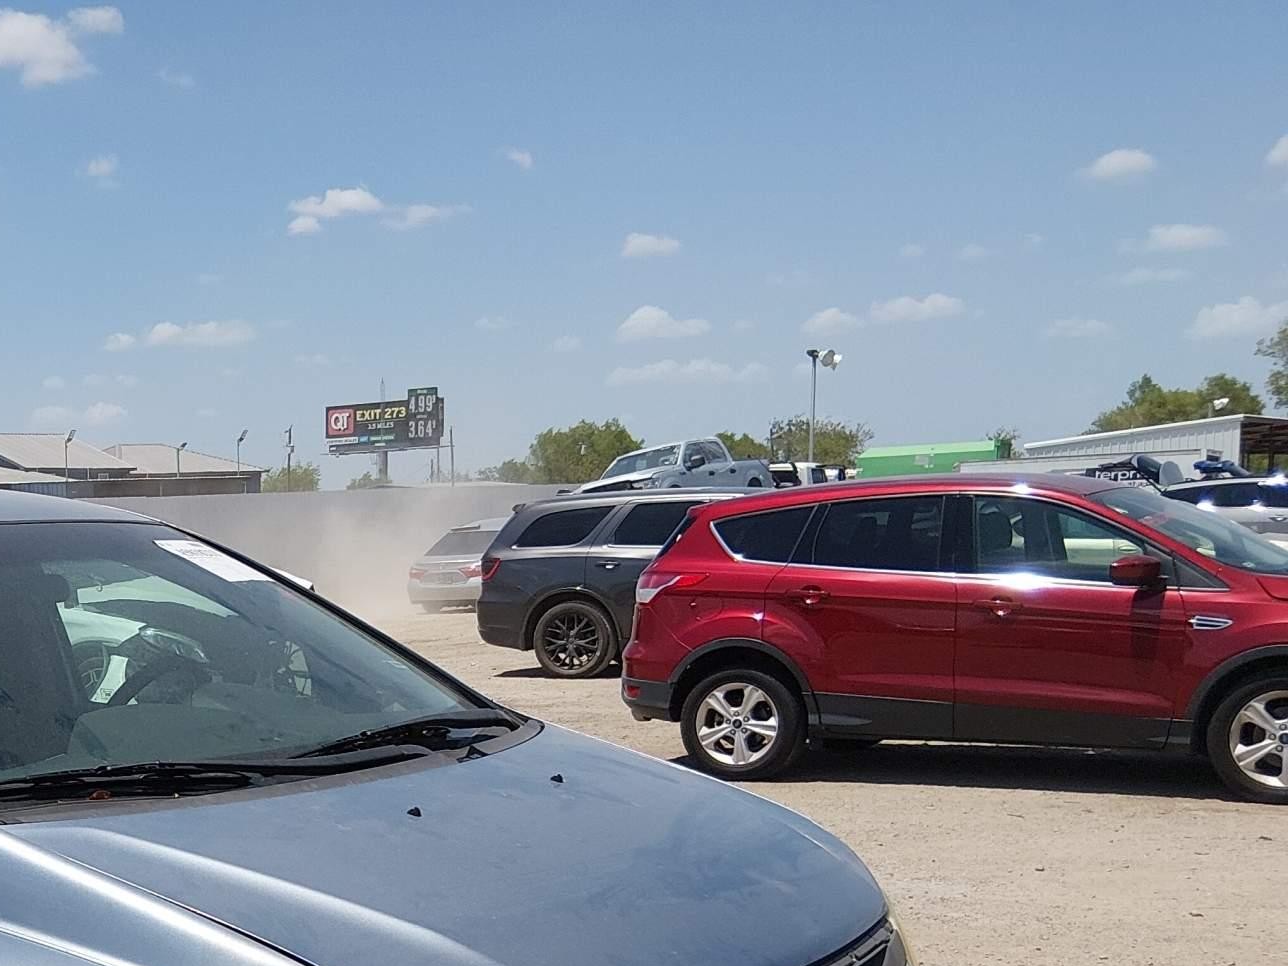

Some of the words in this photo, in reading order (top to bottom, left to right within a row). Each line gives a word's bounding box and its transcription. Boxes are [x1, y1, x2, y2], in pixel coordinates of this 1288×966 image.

[330, 413, 350, 431] QT
[356, 409, 381, 421] EXIT
[384, 406, 406, 419] 273
[408, 420, 432, 438] 3.64
